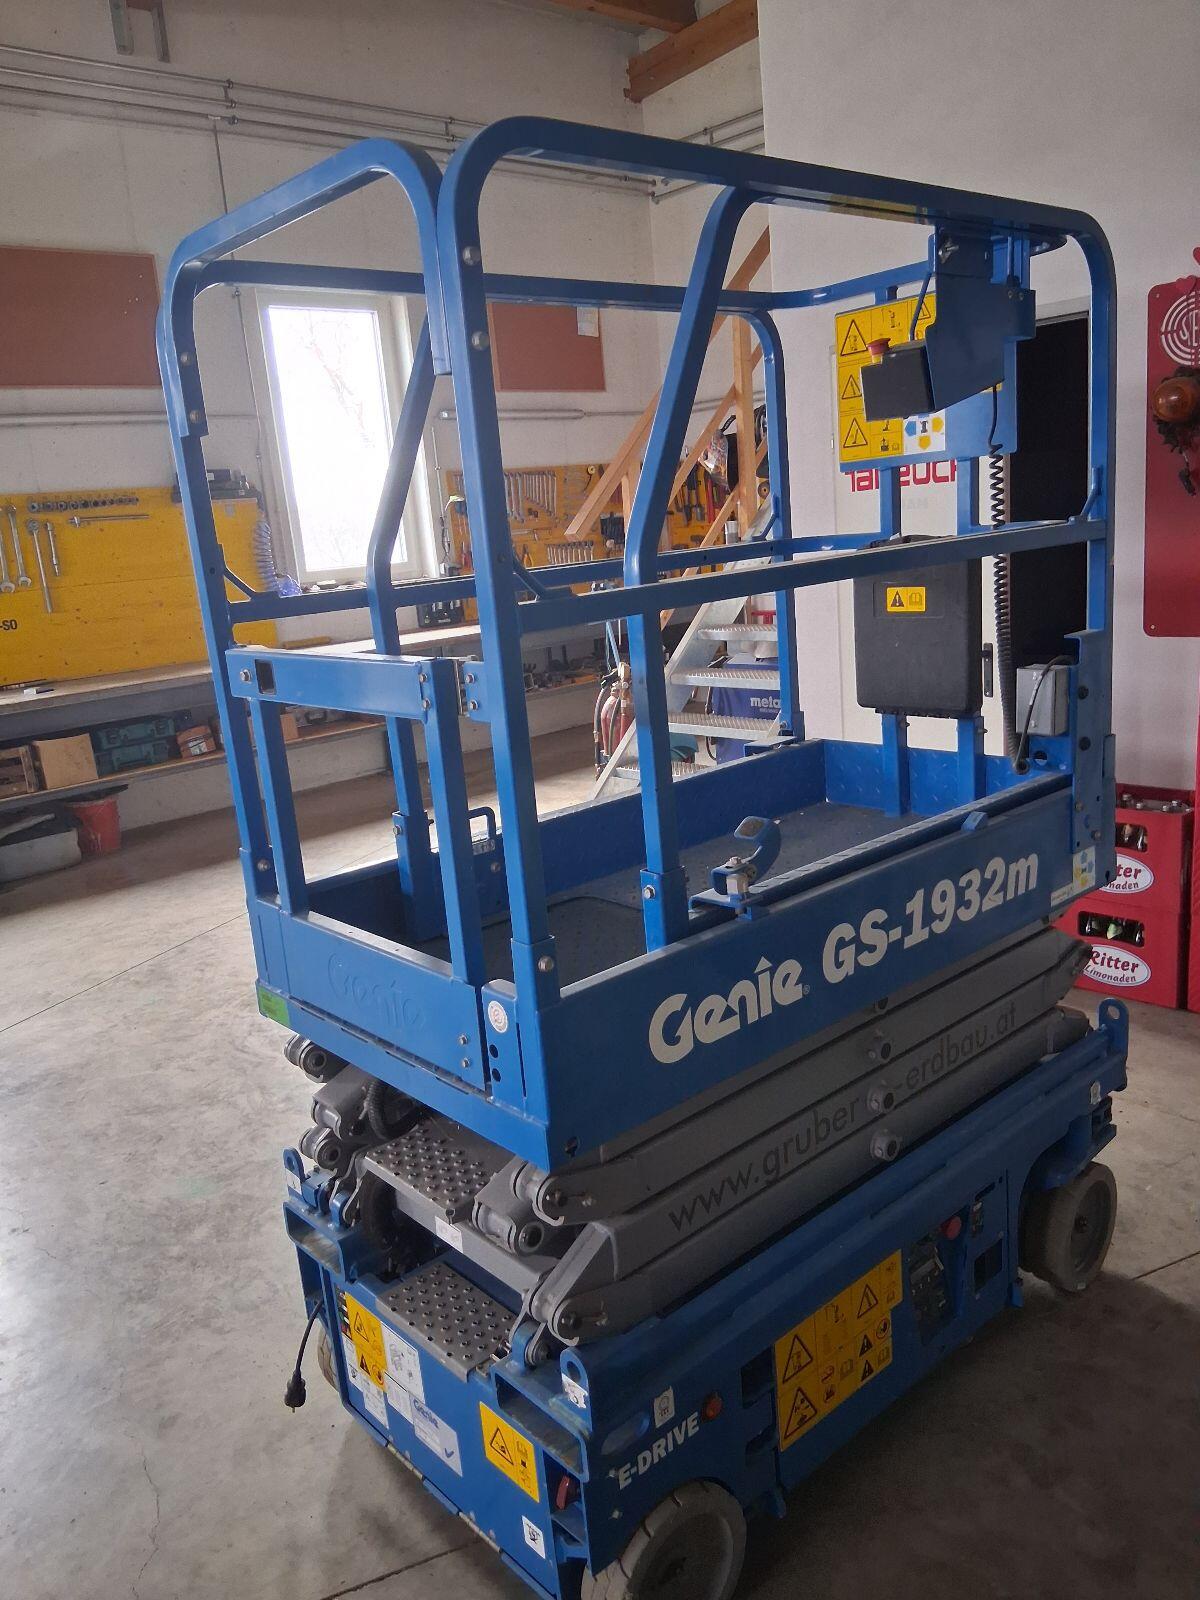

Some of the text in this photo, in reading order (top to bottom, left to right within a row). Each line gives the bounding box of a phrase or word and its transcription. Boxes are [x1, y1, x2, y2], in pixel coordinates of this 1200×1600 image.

[750, 696, 781, 709] meta
[649, 852, 1039, 1064] Genie GS-1932m
[618, 1411, 700, 1490] E-DRIVE
